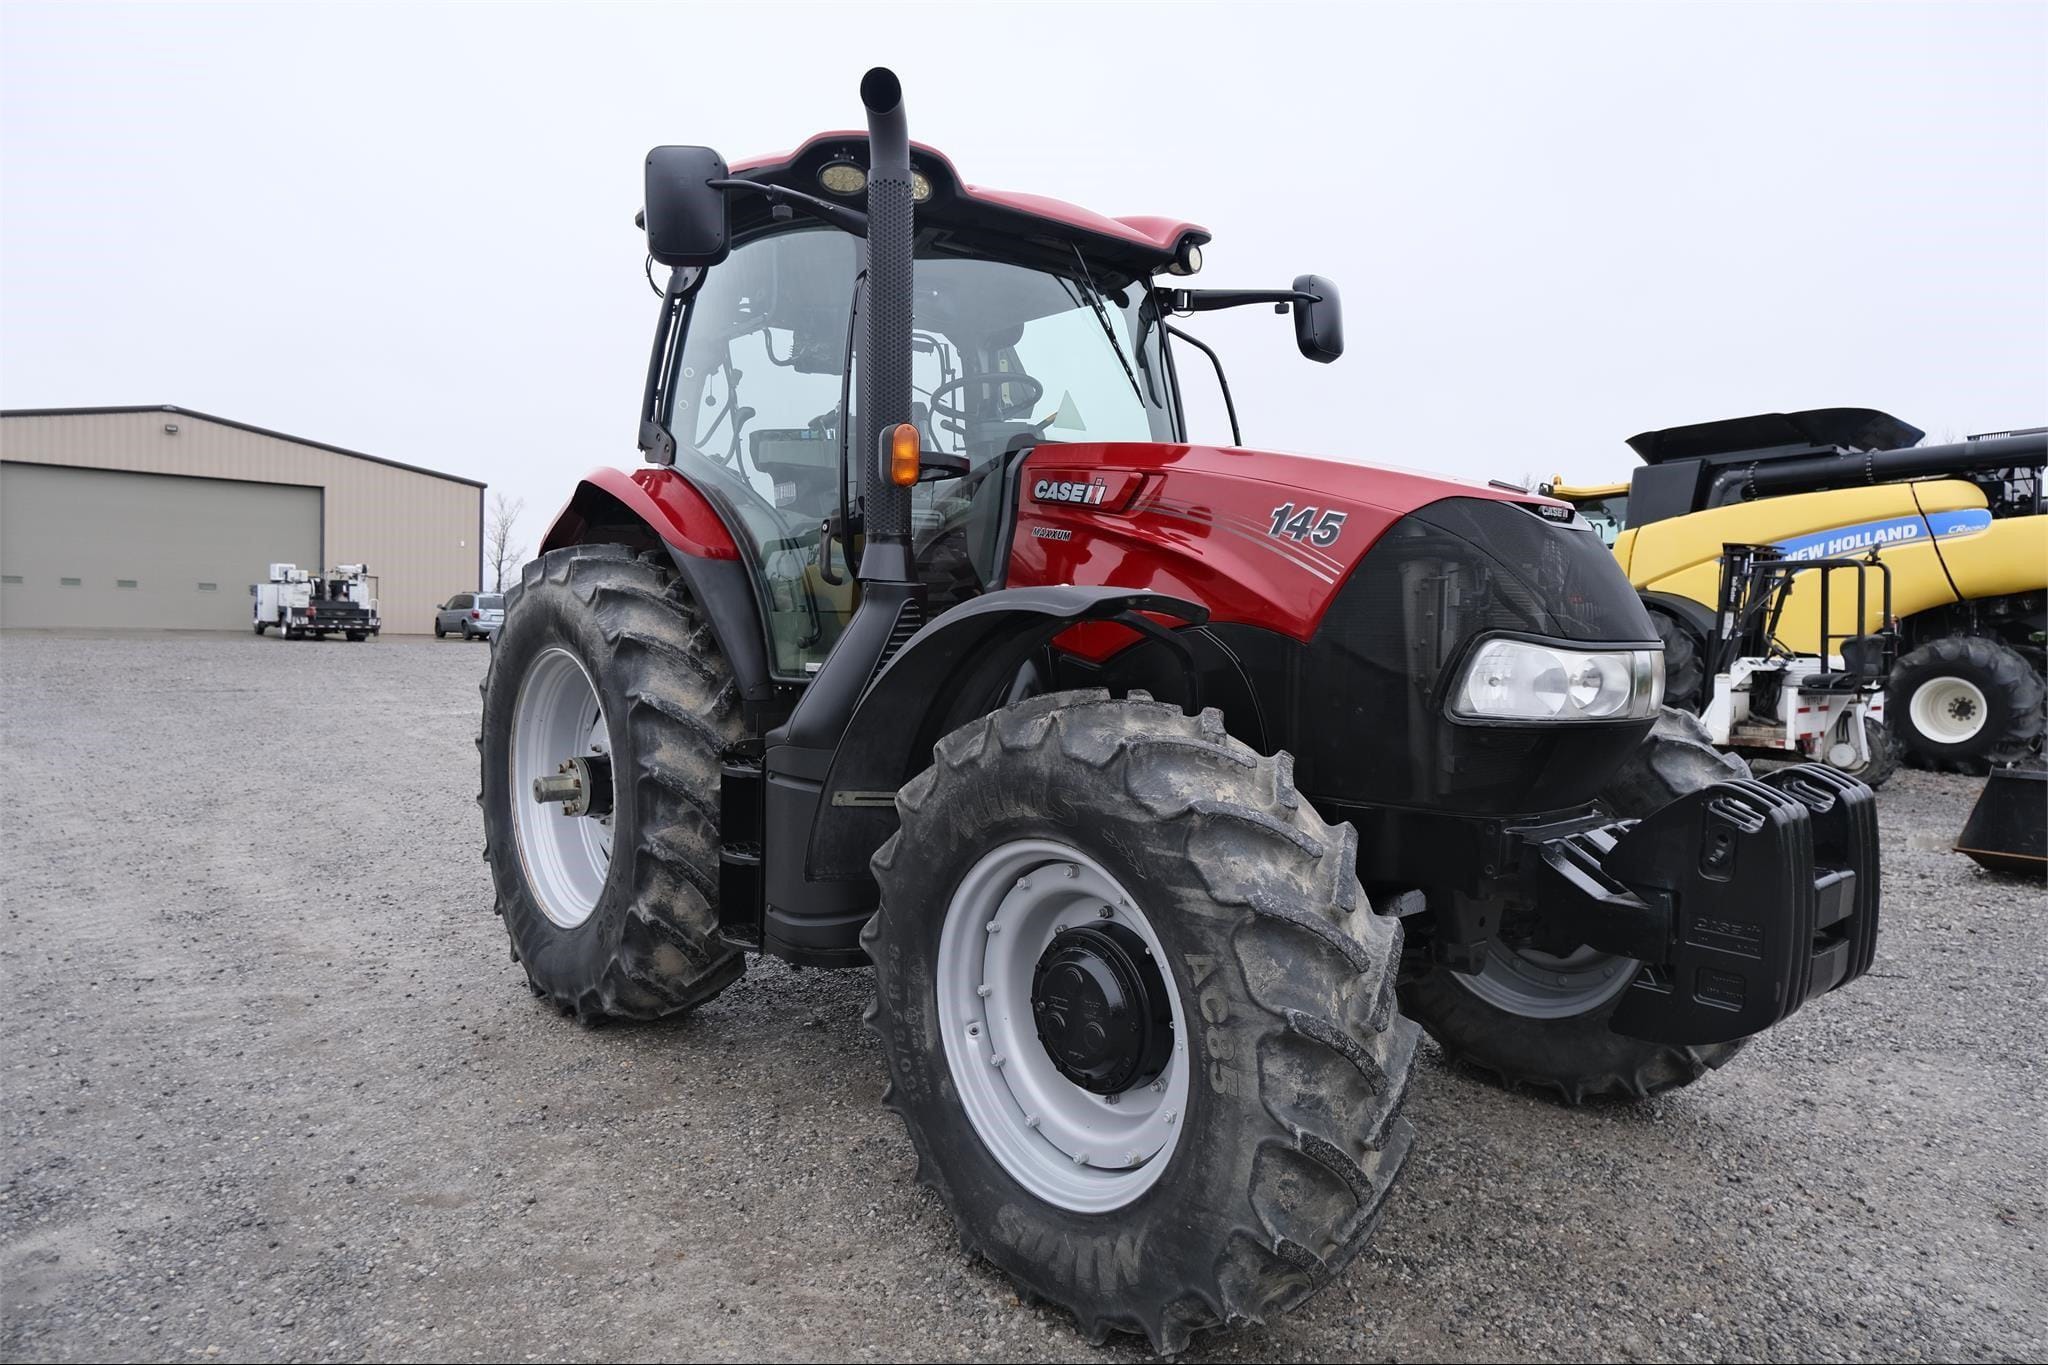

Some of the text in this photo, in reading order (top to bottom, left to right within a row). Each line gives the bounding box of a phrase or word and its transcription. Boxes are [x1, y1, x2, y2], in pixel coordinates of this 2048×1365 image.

[1034, 480, 1085, 502] CASE
[1031, 526, 1072, 542] MAXXUM
[1267, 502, 1348, 548] 145
[1828, 524, 1918, 555] HOLLAND
